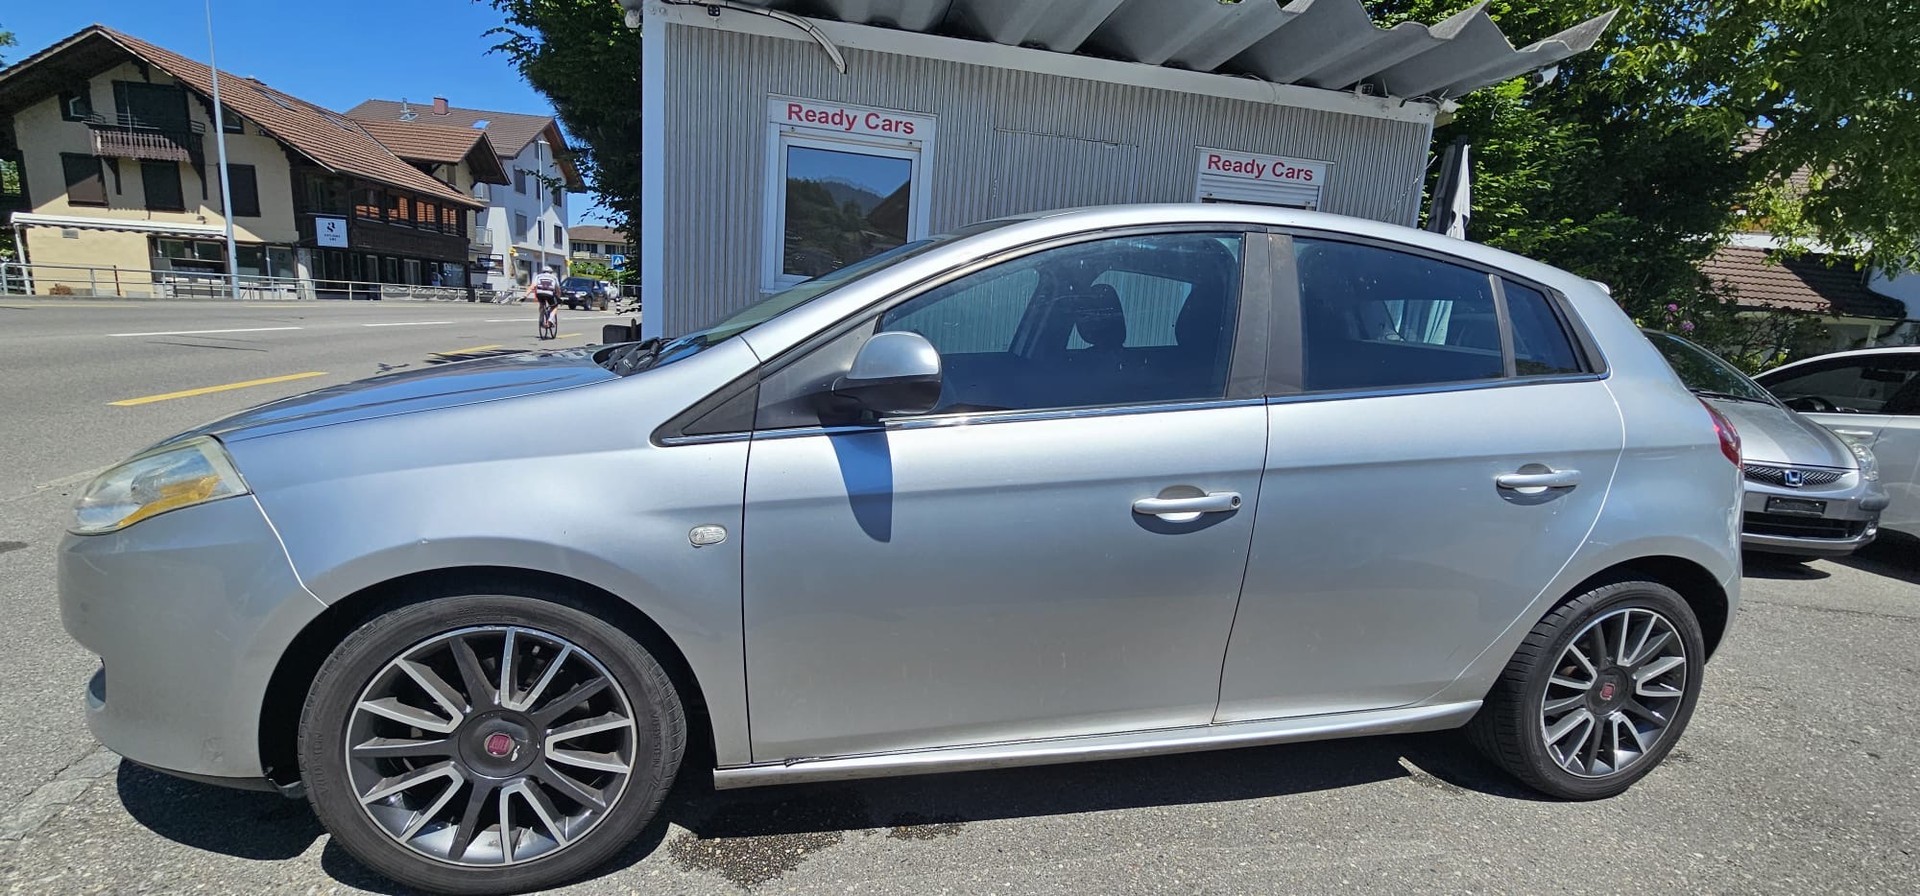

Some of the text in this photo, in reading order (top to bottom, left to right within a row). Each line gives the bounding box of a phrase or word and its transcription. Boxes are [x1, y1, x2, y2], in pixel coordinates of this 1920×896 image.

[787, 103, 915, 135] Ready Cars
[1208, 154, 1314, 181] Ready Cars
